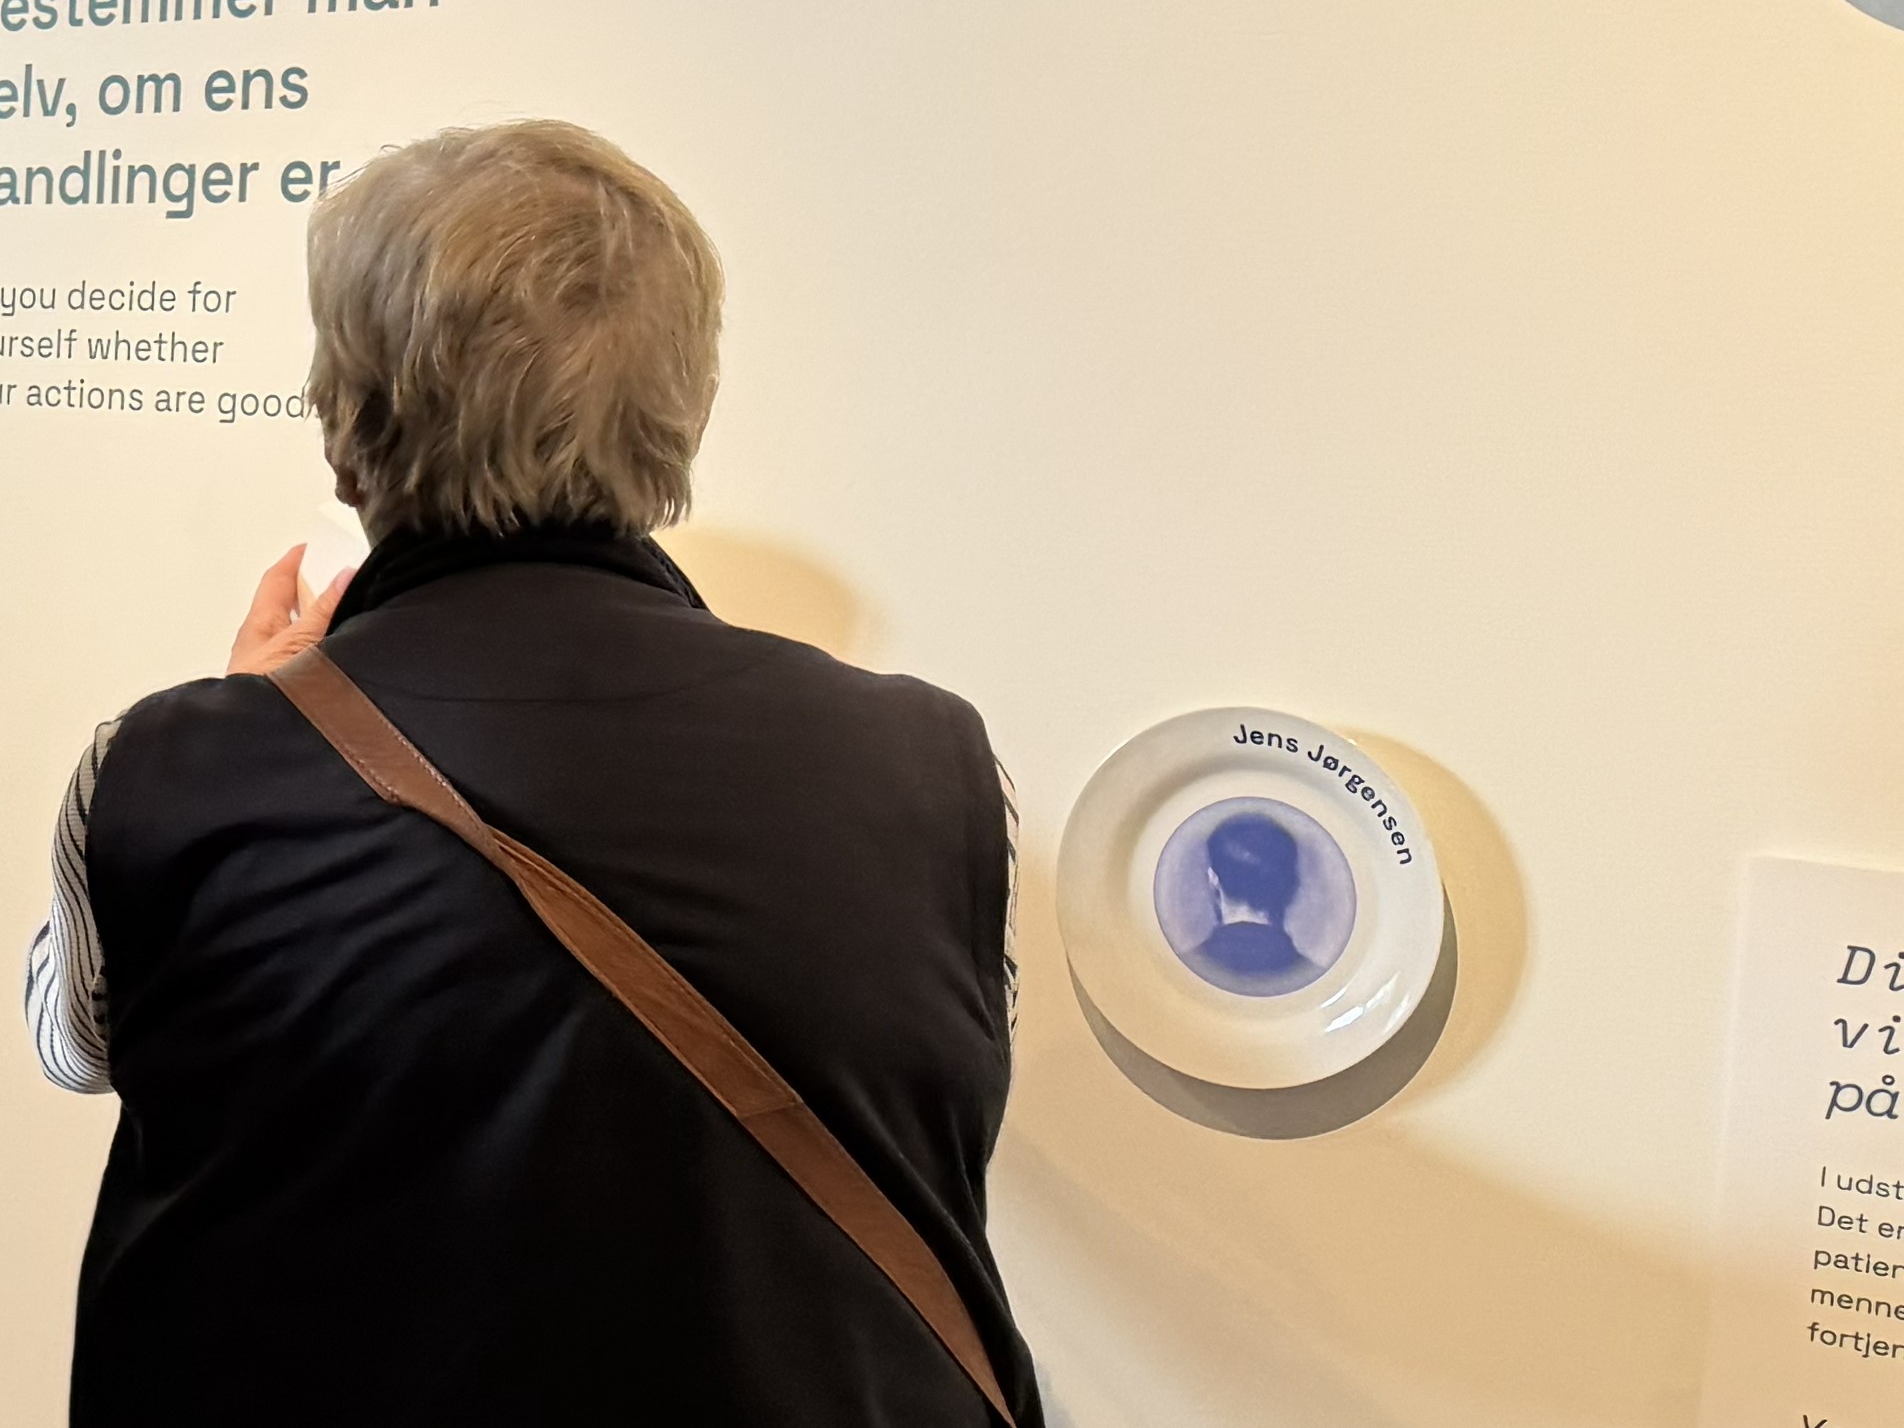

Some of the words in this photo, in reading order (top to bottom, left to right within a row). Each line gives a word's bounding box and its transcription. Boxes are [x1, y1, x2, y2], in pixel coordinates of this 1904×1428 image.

[99, 69, 181, 116] om
[204, 64, 309, 111] ens
[280, 158, 341, 204] er
[0, 281, 57, 317] you
[67, 280, 176, 313] decide
[188, 281, 236, 314] for
[88, 332, 224, 364] whether
[26, 382, 143, 414] actions
[155, 387, 205, 415] are
[1233, 724, 1299, 754] Jens
[1308, 745, 1412, 865] Jørgensen
[1834, 1015, 1901, 1055] vi
[1825, 1074, 1900, 1120] på
[1821, 1166, 1826, 1187] I
[1818, 1205, 1868, 1233] Det
